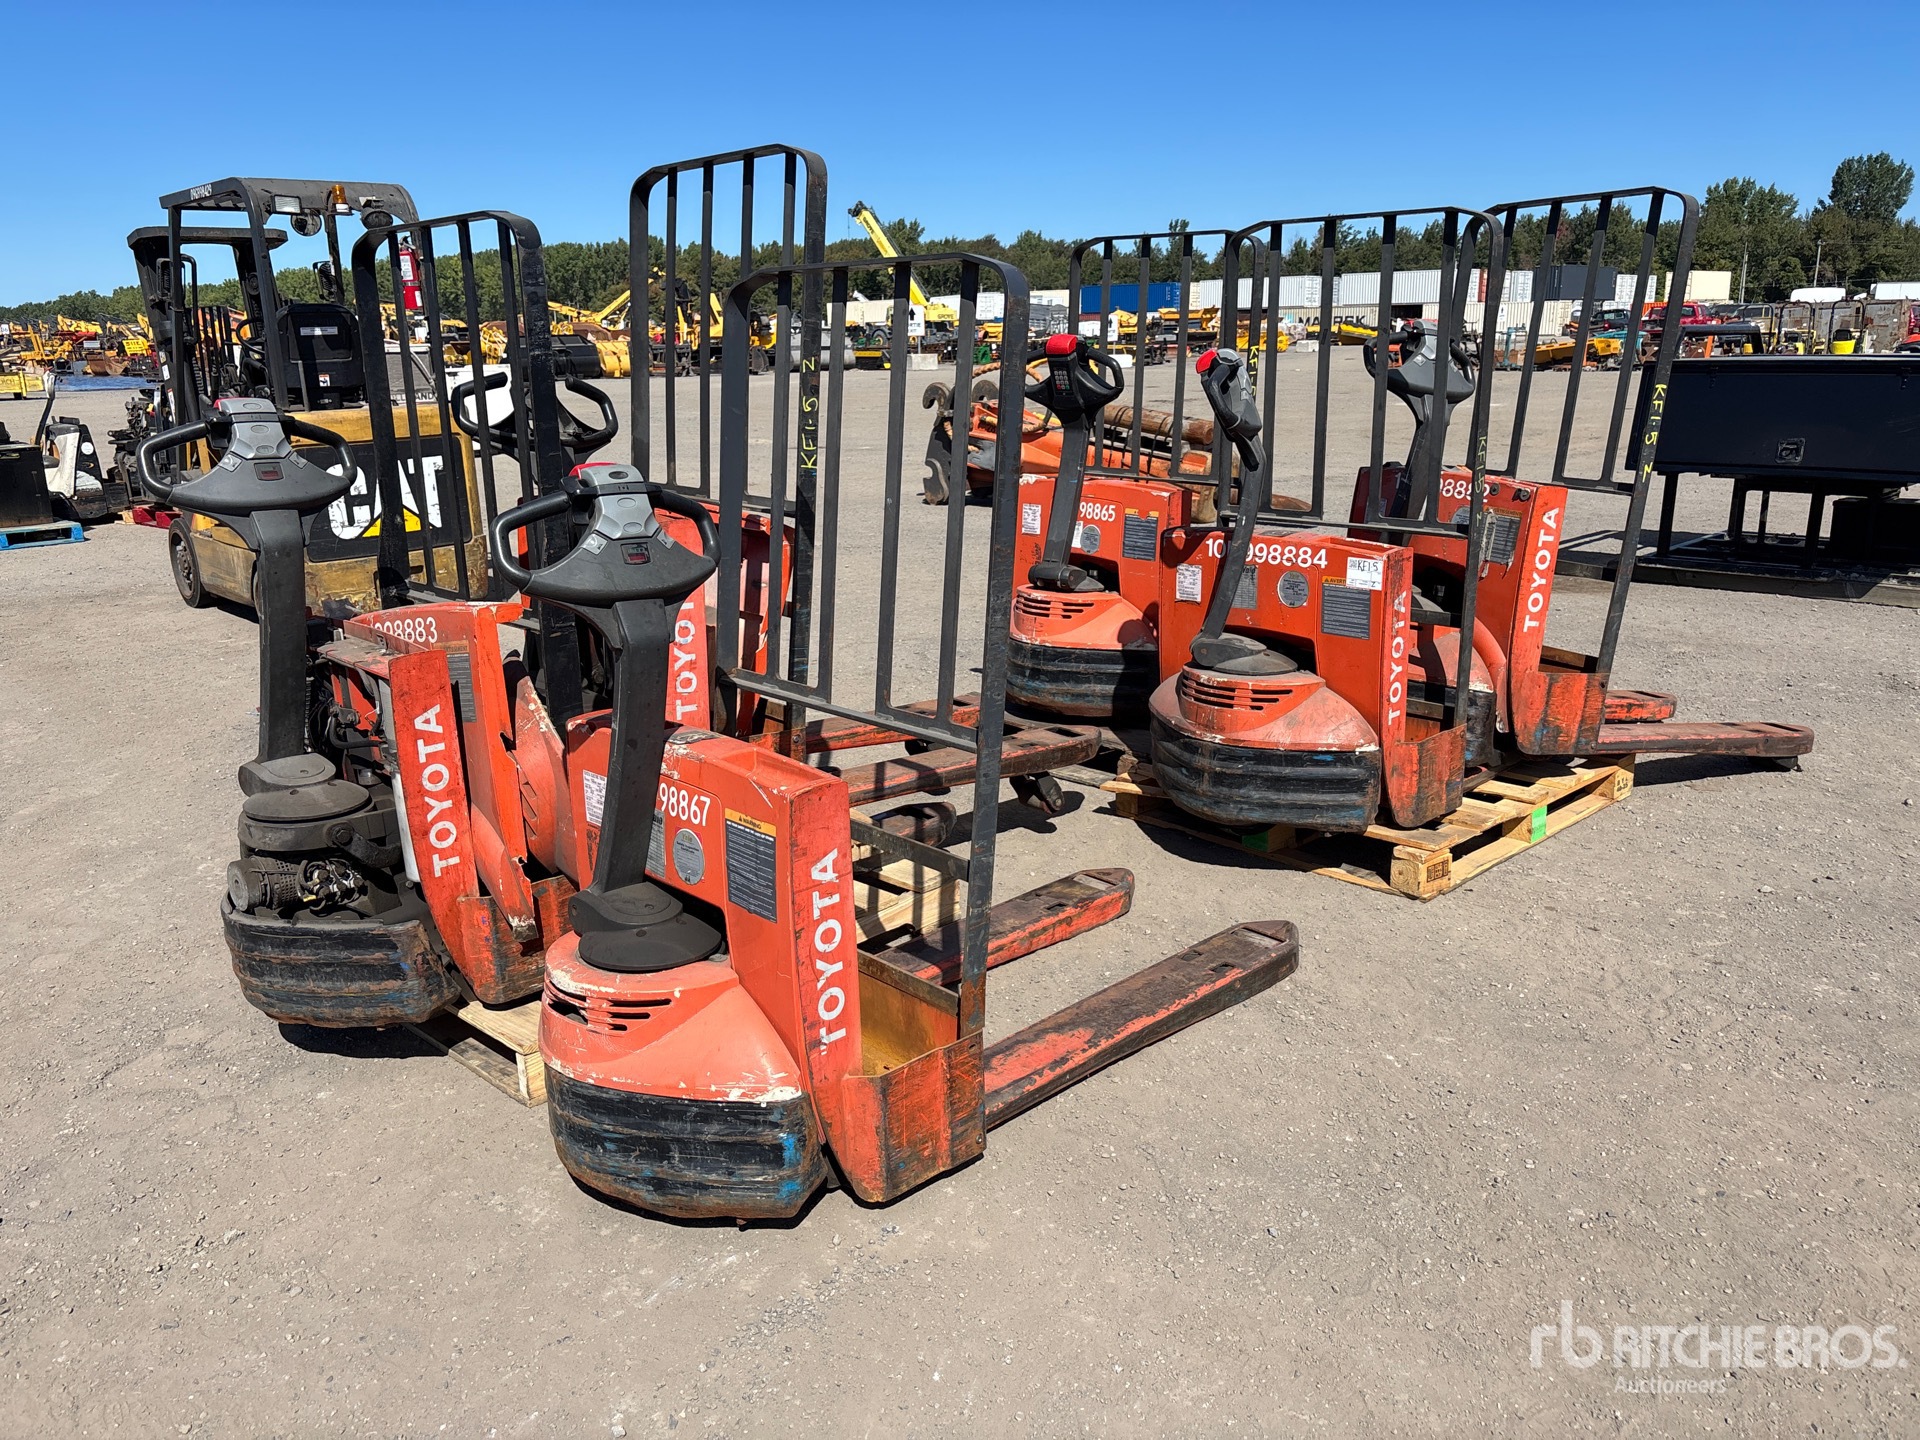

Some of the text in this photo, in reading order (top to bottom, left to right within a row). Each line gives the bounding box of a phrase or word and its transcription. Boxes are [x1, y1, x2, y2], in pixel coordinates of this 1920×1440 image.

[1298, 315, 1367, 327] MARSK
[326, 455, 443, 540] CAT
[1079, 501, 1116, 522] 98865
[1523, 507, 1560, 633] TOYOTA
[1387, 591, 1406, 726] TOYOTA
[413, 703, 461, 878] TOYOTA
[659, 782, 710, 827] 98867
[811, 848, 847, 1056] TOYOTA
